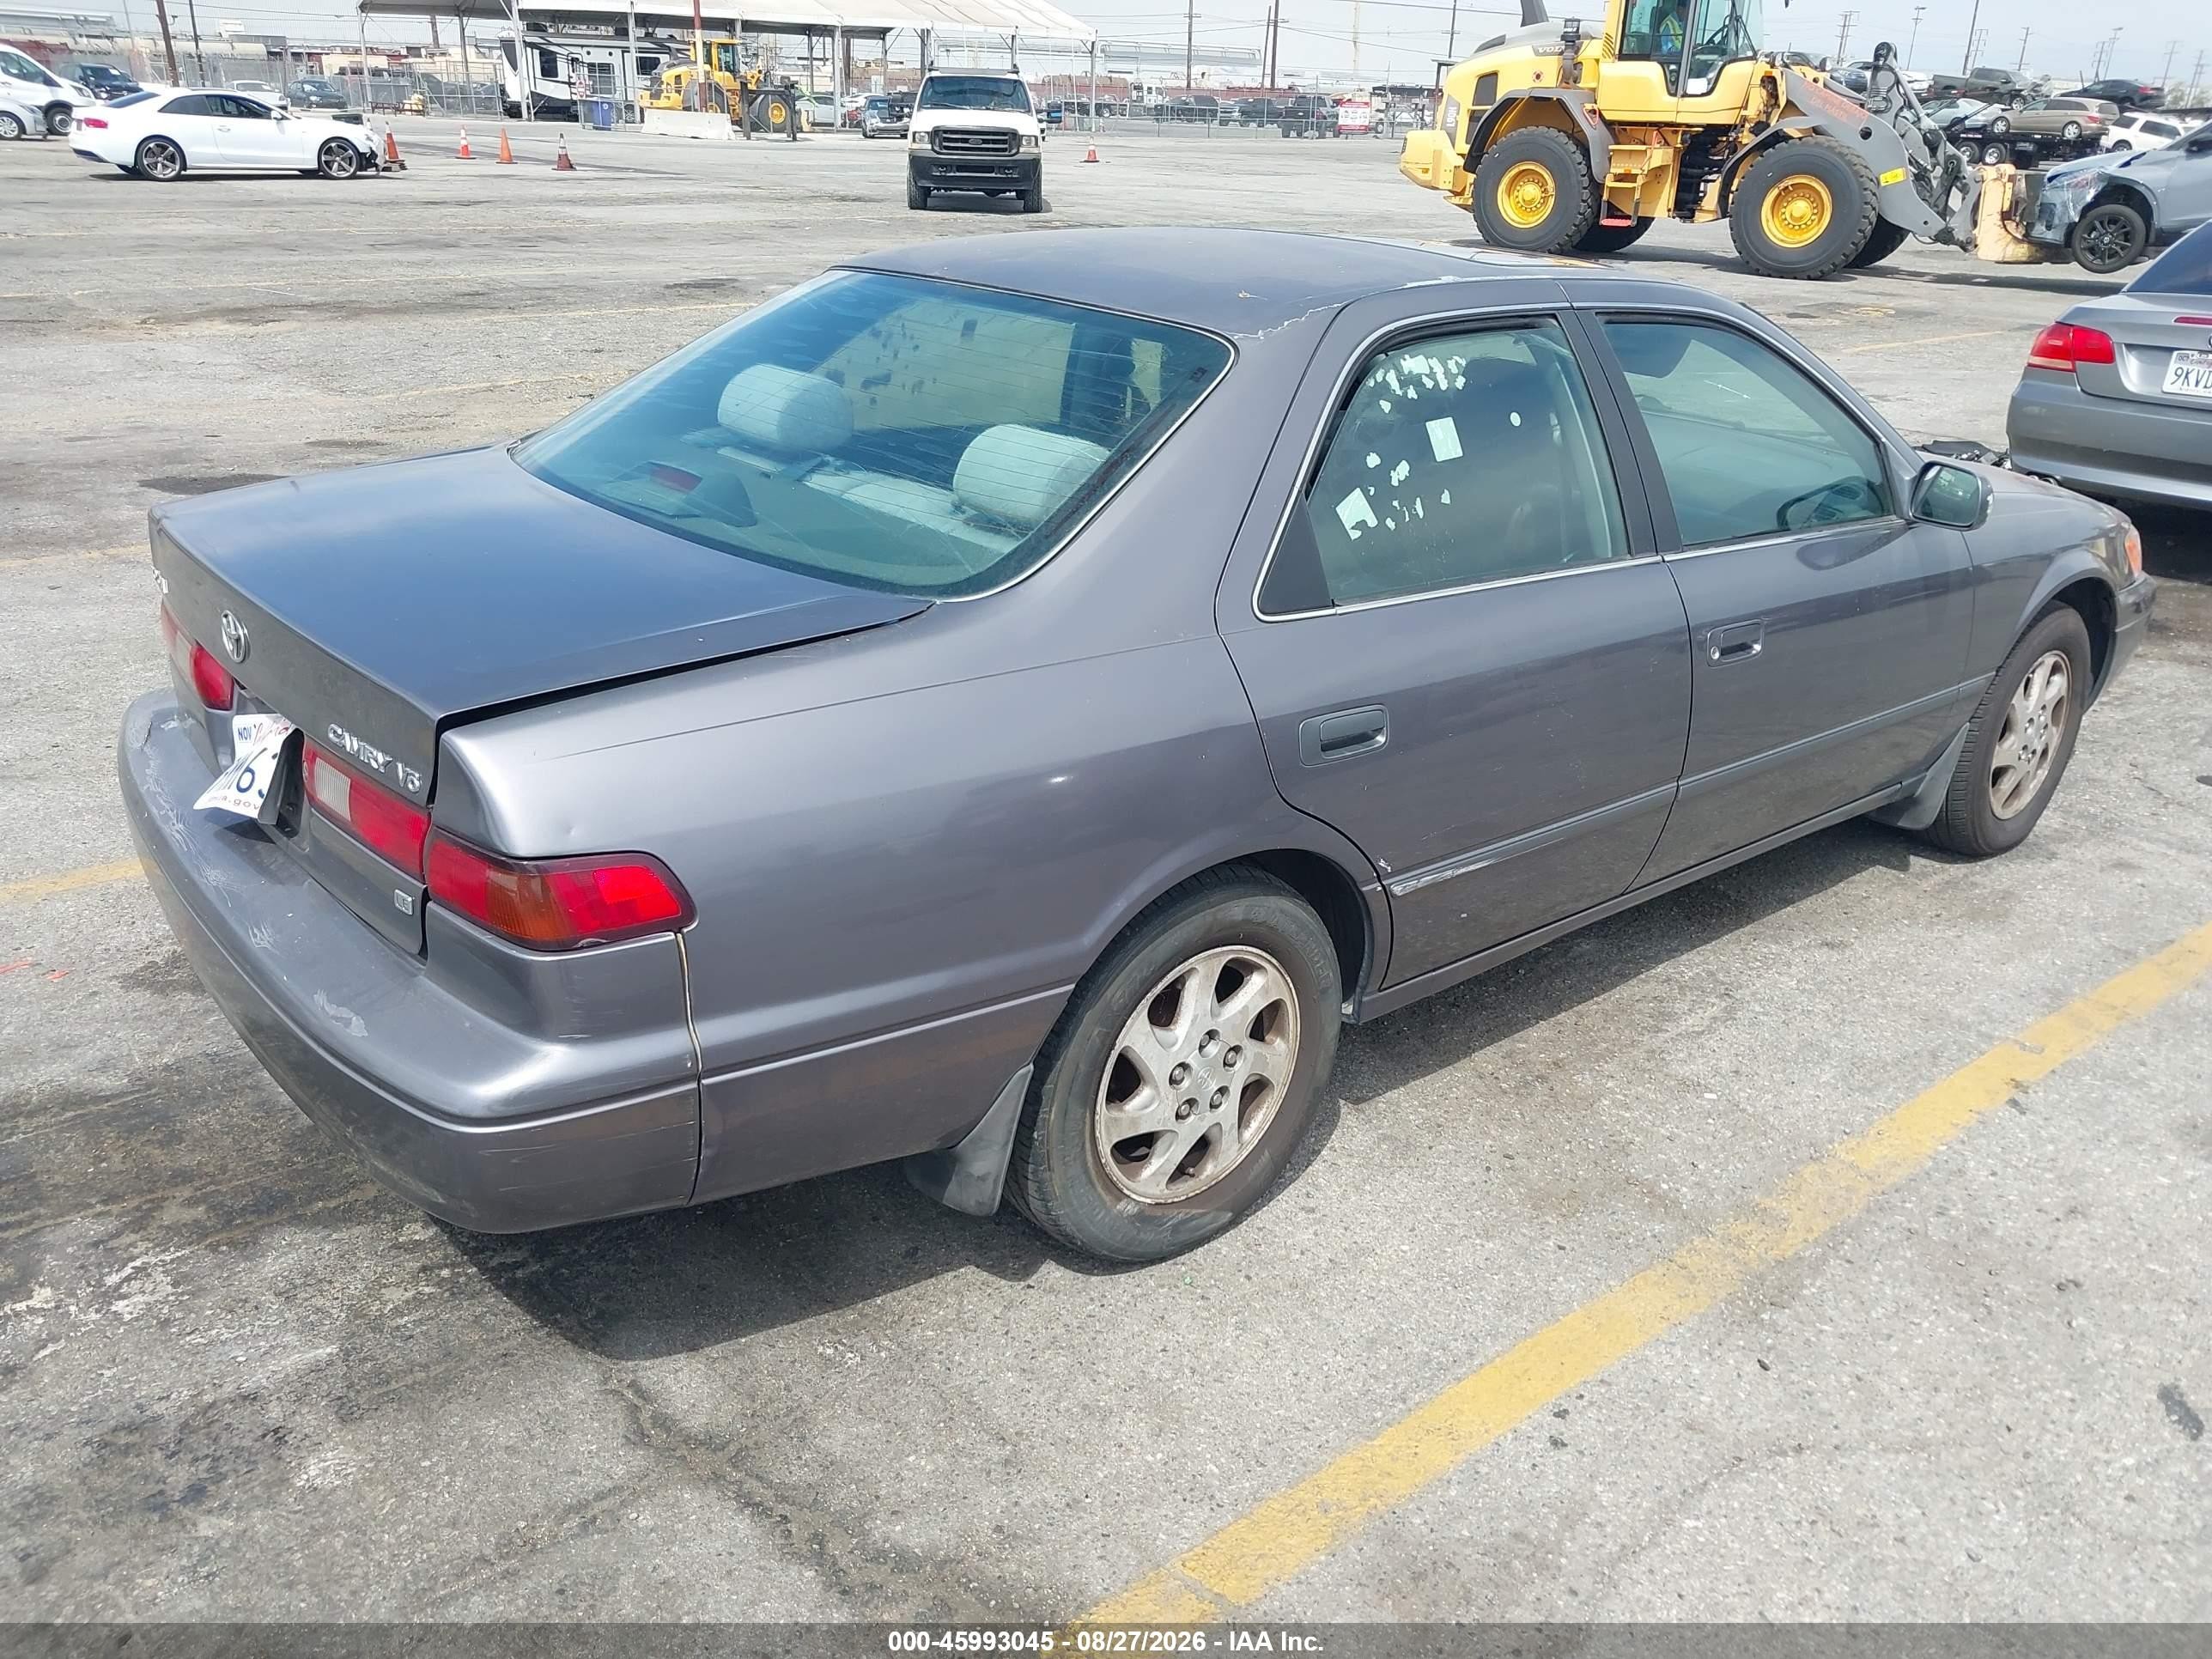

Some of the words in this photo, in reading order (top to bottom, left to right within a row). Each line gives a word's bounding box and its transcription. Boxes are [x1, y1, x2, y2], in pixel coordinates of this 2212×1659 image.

[238, 726, 252, 741] NOV
[328, 723, 393, 773] CAMRY
[396, 762, 422, 793] V6
